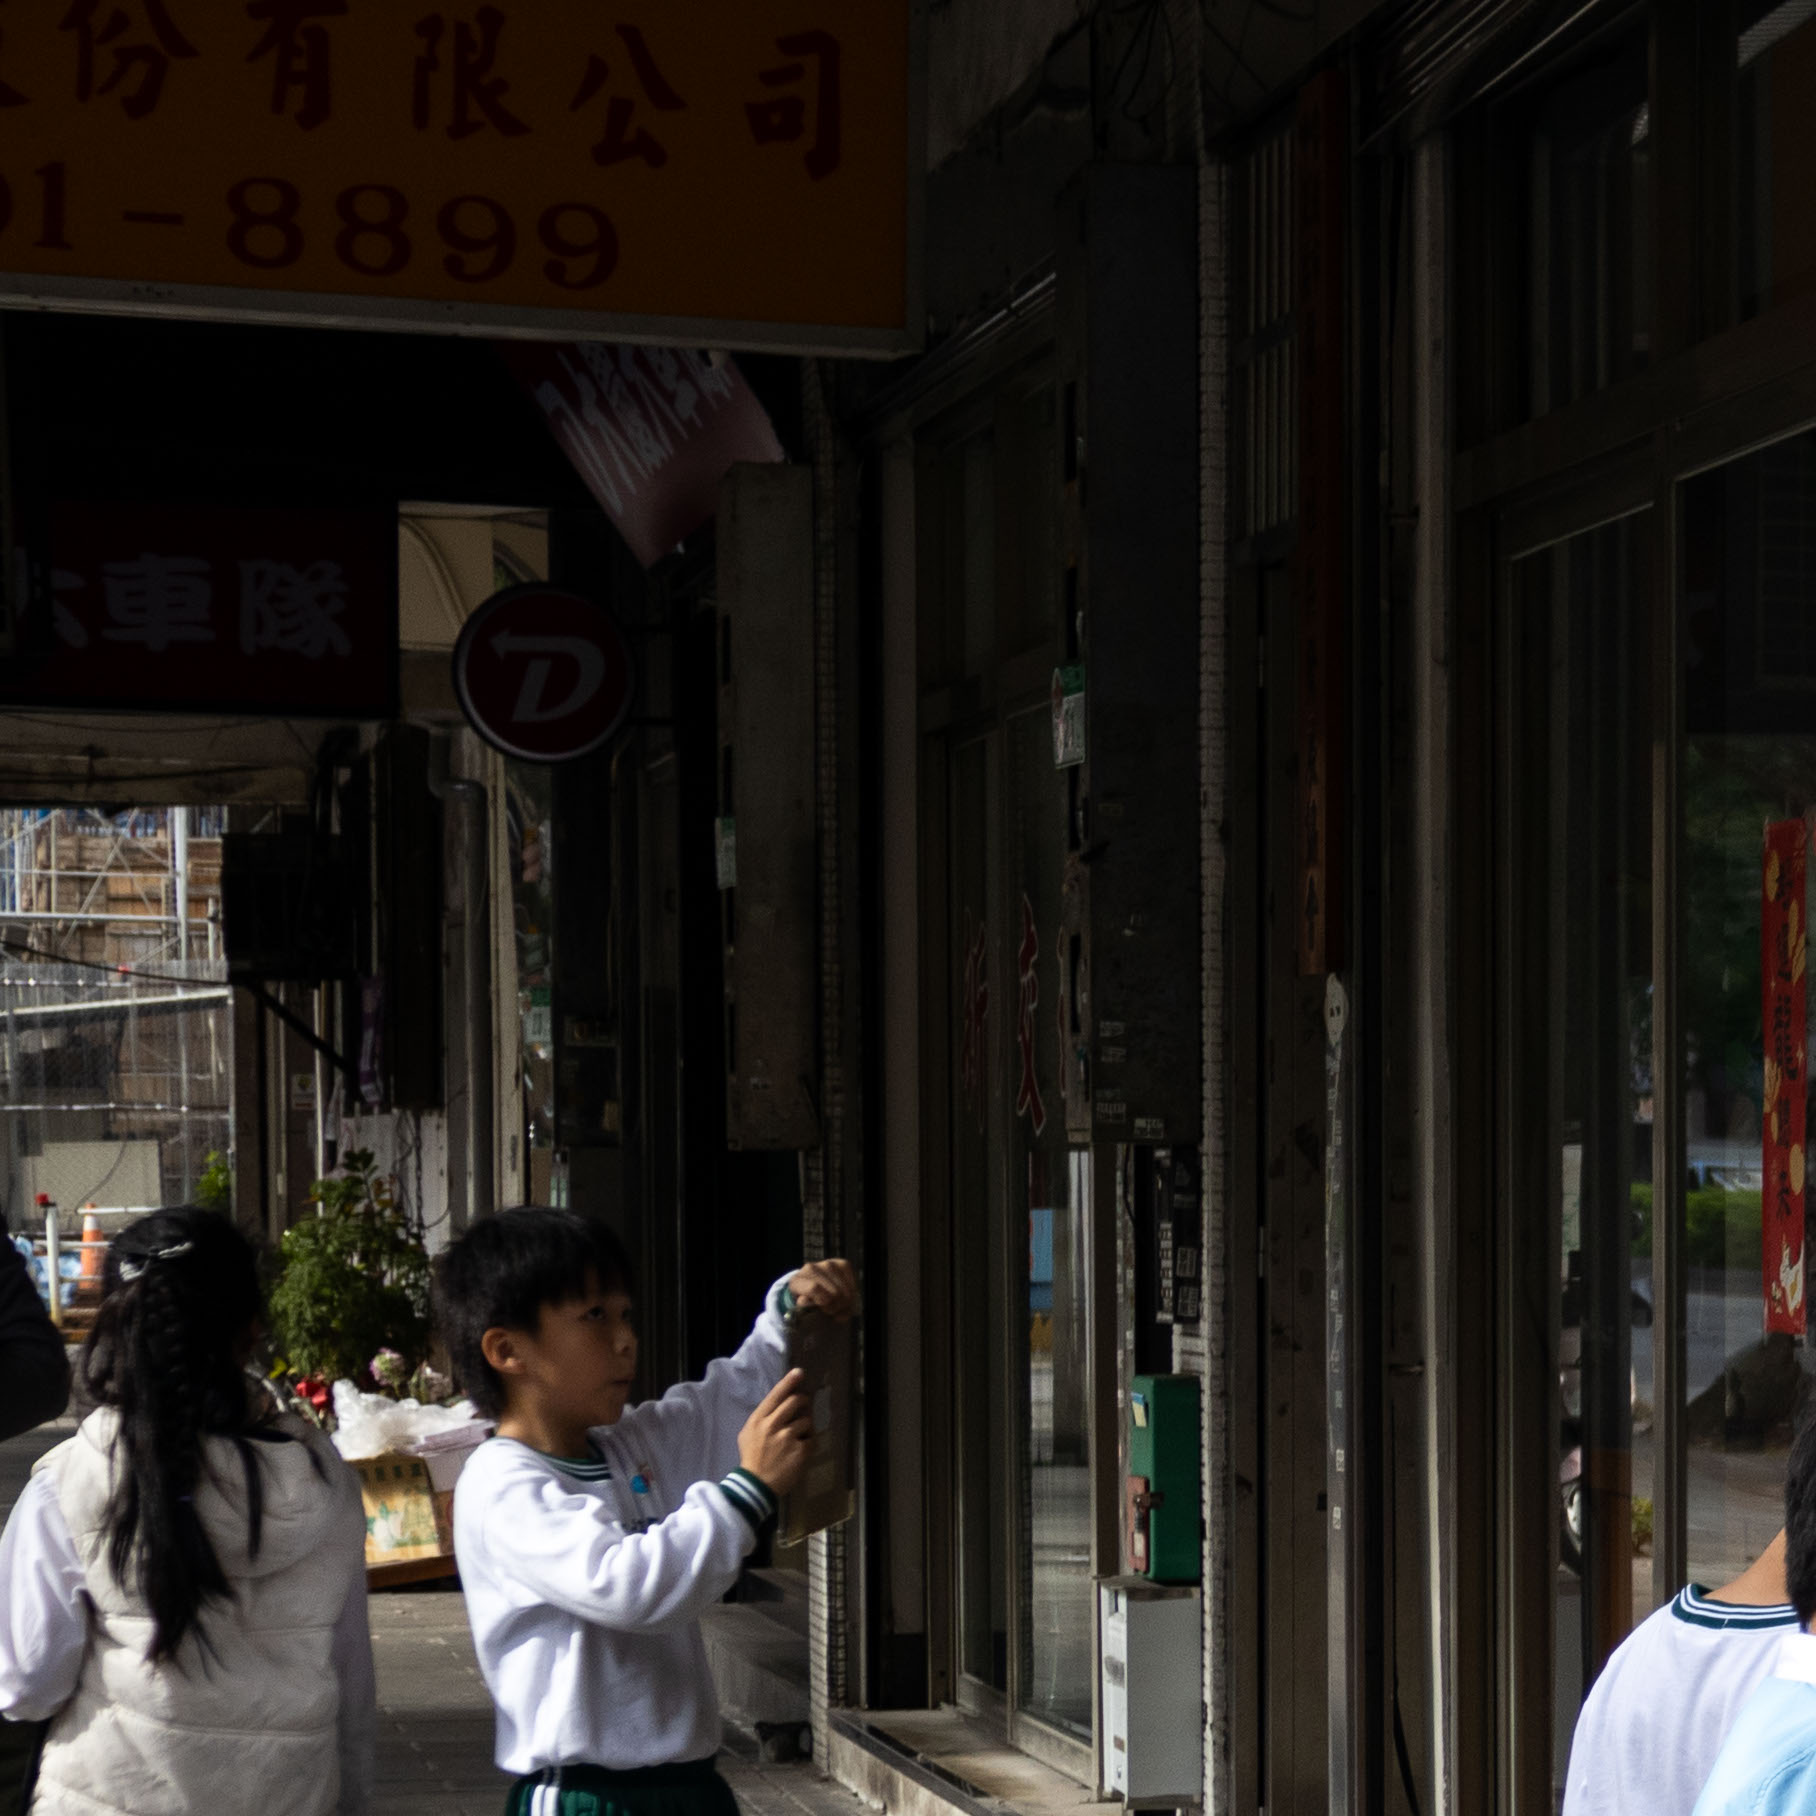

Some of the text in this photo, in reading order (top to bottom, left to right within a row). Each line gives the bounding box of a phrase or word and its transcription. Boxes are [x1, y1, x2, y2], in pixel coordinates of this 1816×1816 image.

[0, 0, 843, 181] 份有限公司
